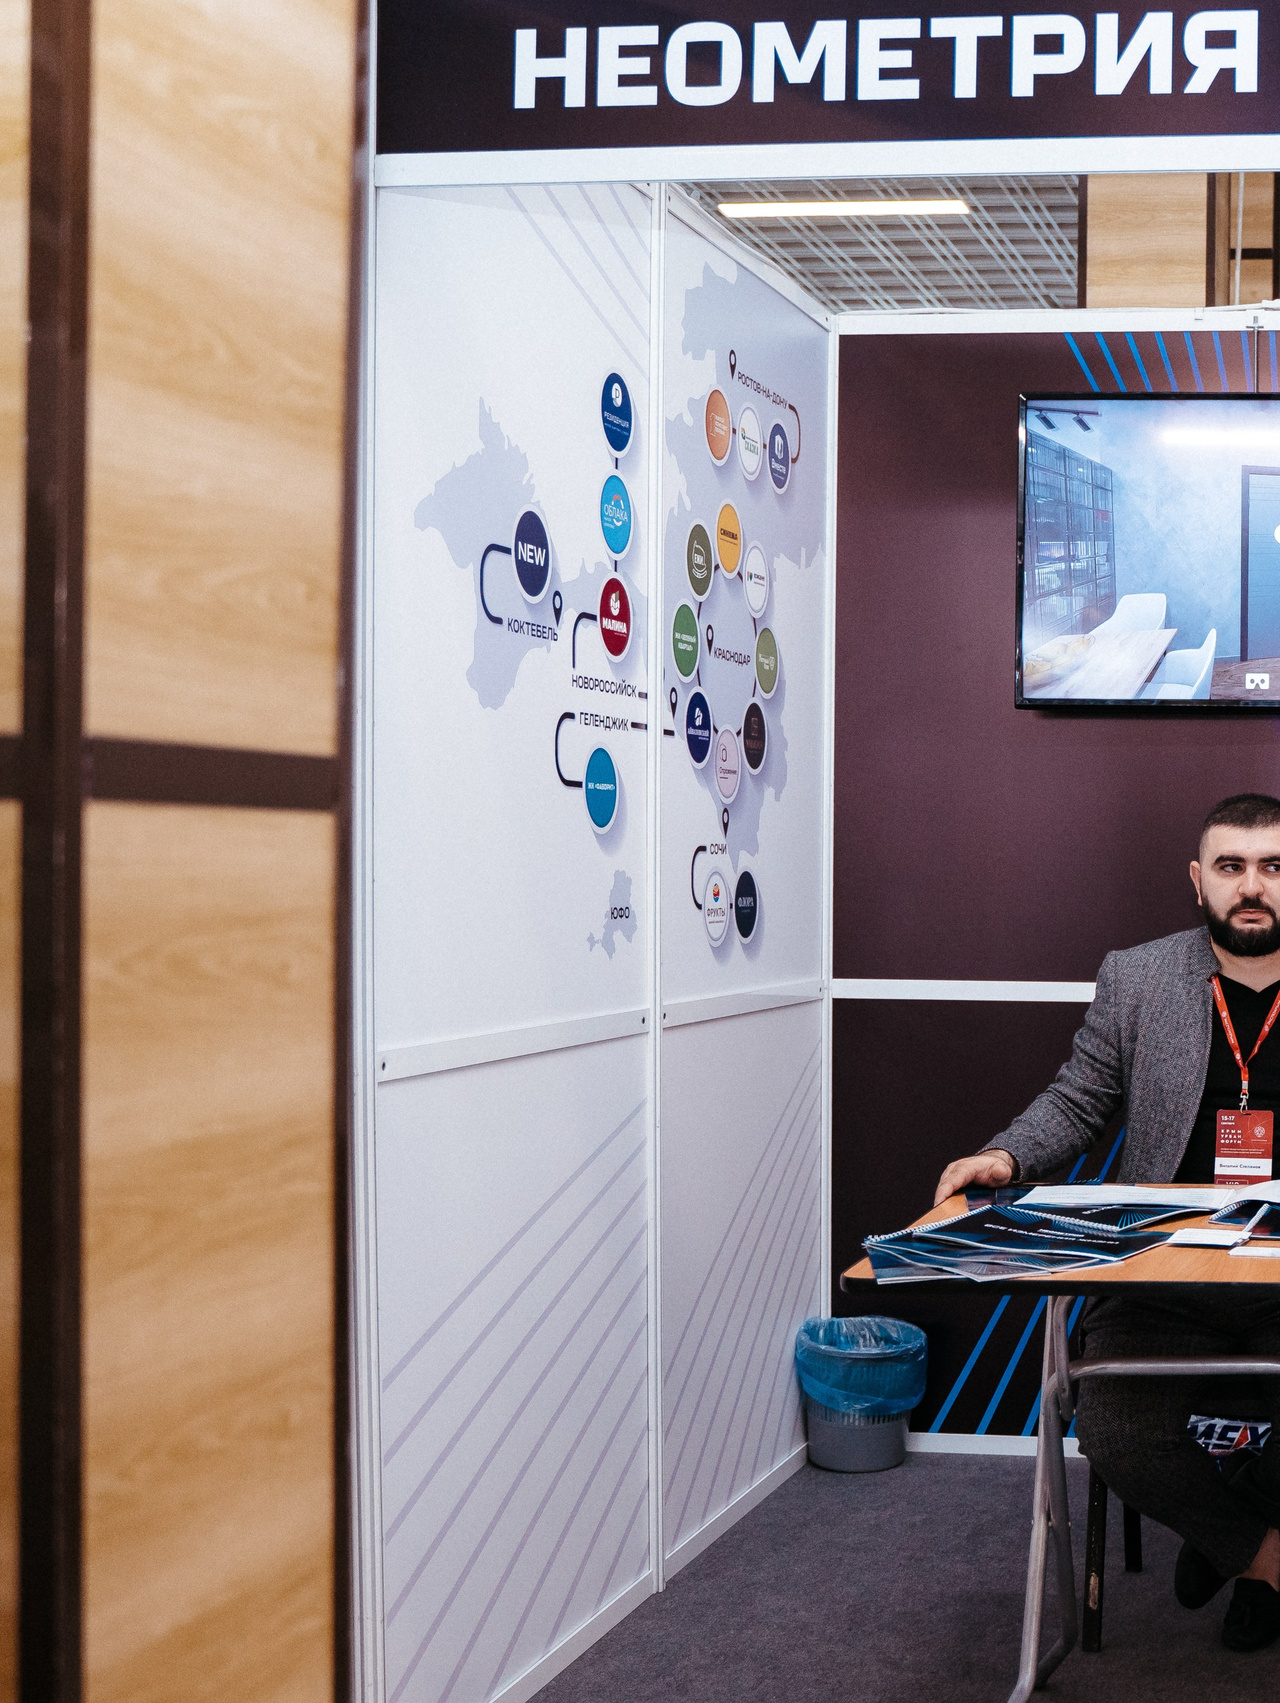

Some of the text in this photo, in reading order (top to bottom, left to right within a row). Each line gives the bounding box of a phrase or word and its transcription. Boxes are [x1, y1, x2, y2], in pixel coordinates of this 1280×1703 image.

[513, 9, 1258, 109] НЕОМЕТРИЯ
[738, 371, 788, 409] РОСТОВ-НА-ДОНУ
[603, 503, 628, 522] ОБЛАКА
[518, 541, 546, 567] NEW
[507, 618, 559, 642] КОКТЕБЕЛЬ
[602, 617, 628, 634] МАЛИНА
[714, 647, 751, 667] КРАСНОДАР
[572, 674, 637, 698] НОВОРОССИЙСК
[579, 712, 629, 731] ГЕЛЕНДЖИК
[710, 843, 727, 855] СОЧИ
[610, 905, 630, 920] ЮФО
[707, 908, 726, 918] ФРУКТЫ
